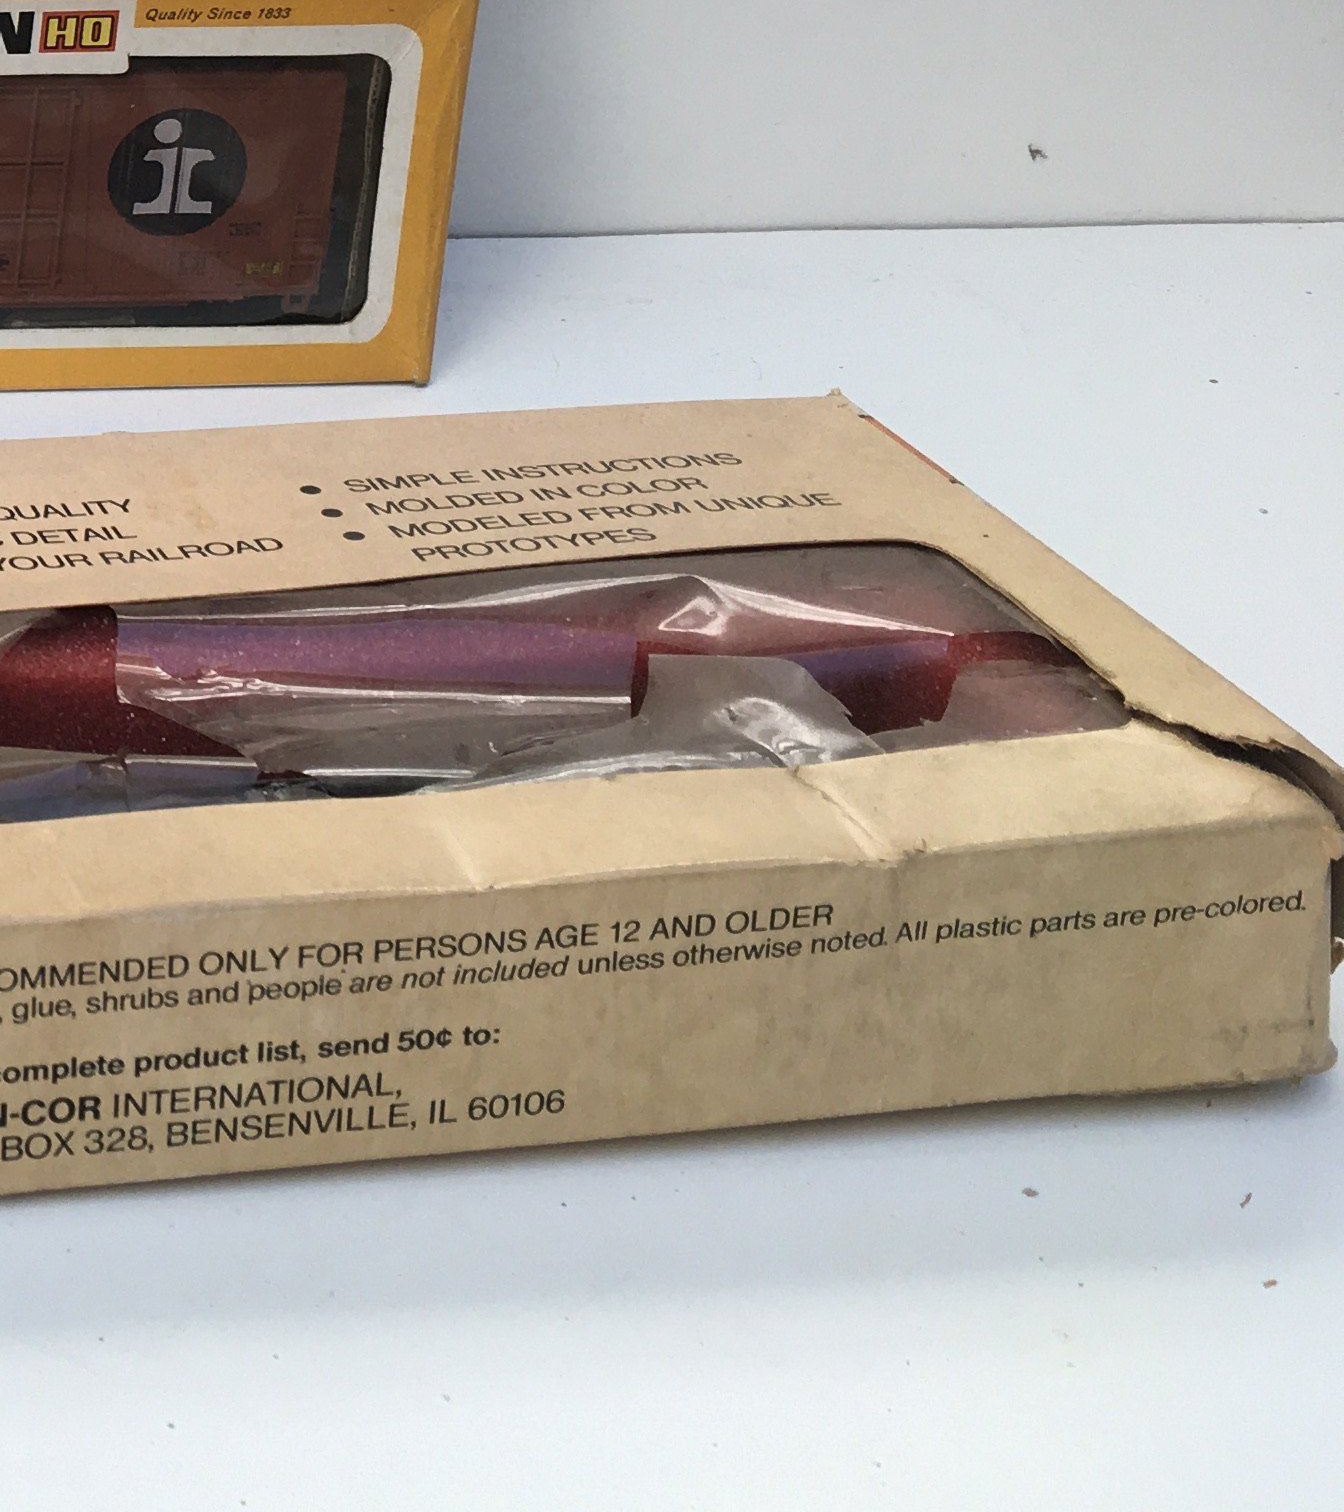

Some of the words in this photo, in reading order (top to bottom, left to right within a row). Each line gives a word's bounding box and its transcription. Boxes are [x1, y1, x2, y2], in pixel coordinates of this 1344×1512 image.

[45, 16, 113, 50] HO
[145, 6, 204, 23] Quality
[206, 6, 252, 21] Since
[257, 6, 292, 20] 1833
[343, 468, 476, 494] SIMPLE
[481, 451, 743, 483] INSTRUCTIONS
[365, 490, 525, 517] MOLDED
[530, 486, 571, 502] IN
[576, 475, 710, 499] COLOR
[387, 510, 573, 541] MODELED
[578, 502, 688, 524] FROM
[690, 492, 843, 515] UNIQUE
[10, 524, 138, 547] DETAIL
[97, 536, 284, 567] RAILROAD
[411, 528, 657, 563] PROTOTYPES
[10, 996, 78, 1026] glue,
[85, 985, 181, 1016] shrubs
[185, 981, 240, 1007] and
[245, 975, 343, 1008] people
[348, 973, 394, 995] are
[400, 967, 446, 991] not
[452, 957, 570, 987] included
[576, 949, 666, 976] unless
[672, 937, 803, 968] otherwise
[810, 925, 889, 955] noted.
[895, 921, 928, 944] All
[934, 915, 1023, 944] plastic
[1028, 910, 1097, 938] parts
[1102, 909, 1147, 929] are
[1152, 889, 1308, 928] pre-colored.
[198, 944, 291, 978] ONLY
[296, 940, 365, 969] FOR
[373, 928, 528, 965] PERSONS
[534, 922, 600, 951] AGE
[610, 920, 642, 944] 12
[648, 912, 717, 941] AND
[724, 903, 835, 936] OLDER
[133, 1044, 249, 1078] product
[256, 1039, 308, 1069] list,
[317, 1030, 390, 1058] send
[397, 1026, 453, 1054] 50¢
[461, 1025, 502, 1049] to:
[112, 1072, 404, 1120] INTERNATIONAL,
[0, 1129, 76, 1163] BOX
[83, 1125, 157, 1158] 328,
[165, 1101, 419, 1150] BENSENVILLE,
[427, 1097, 457, 1125] IL
[467, 1089, 567, 1121] 60106
